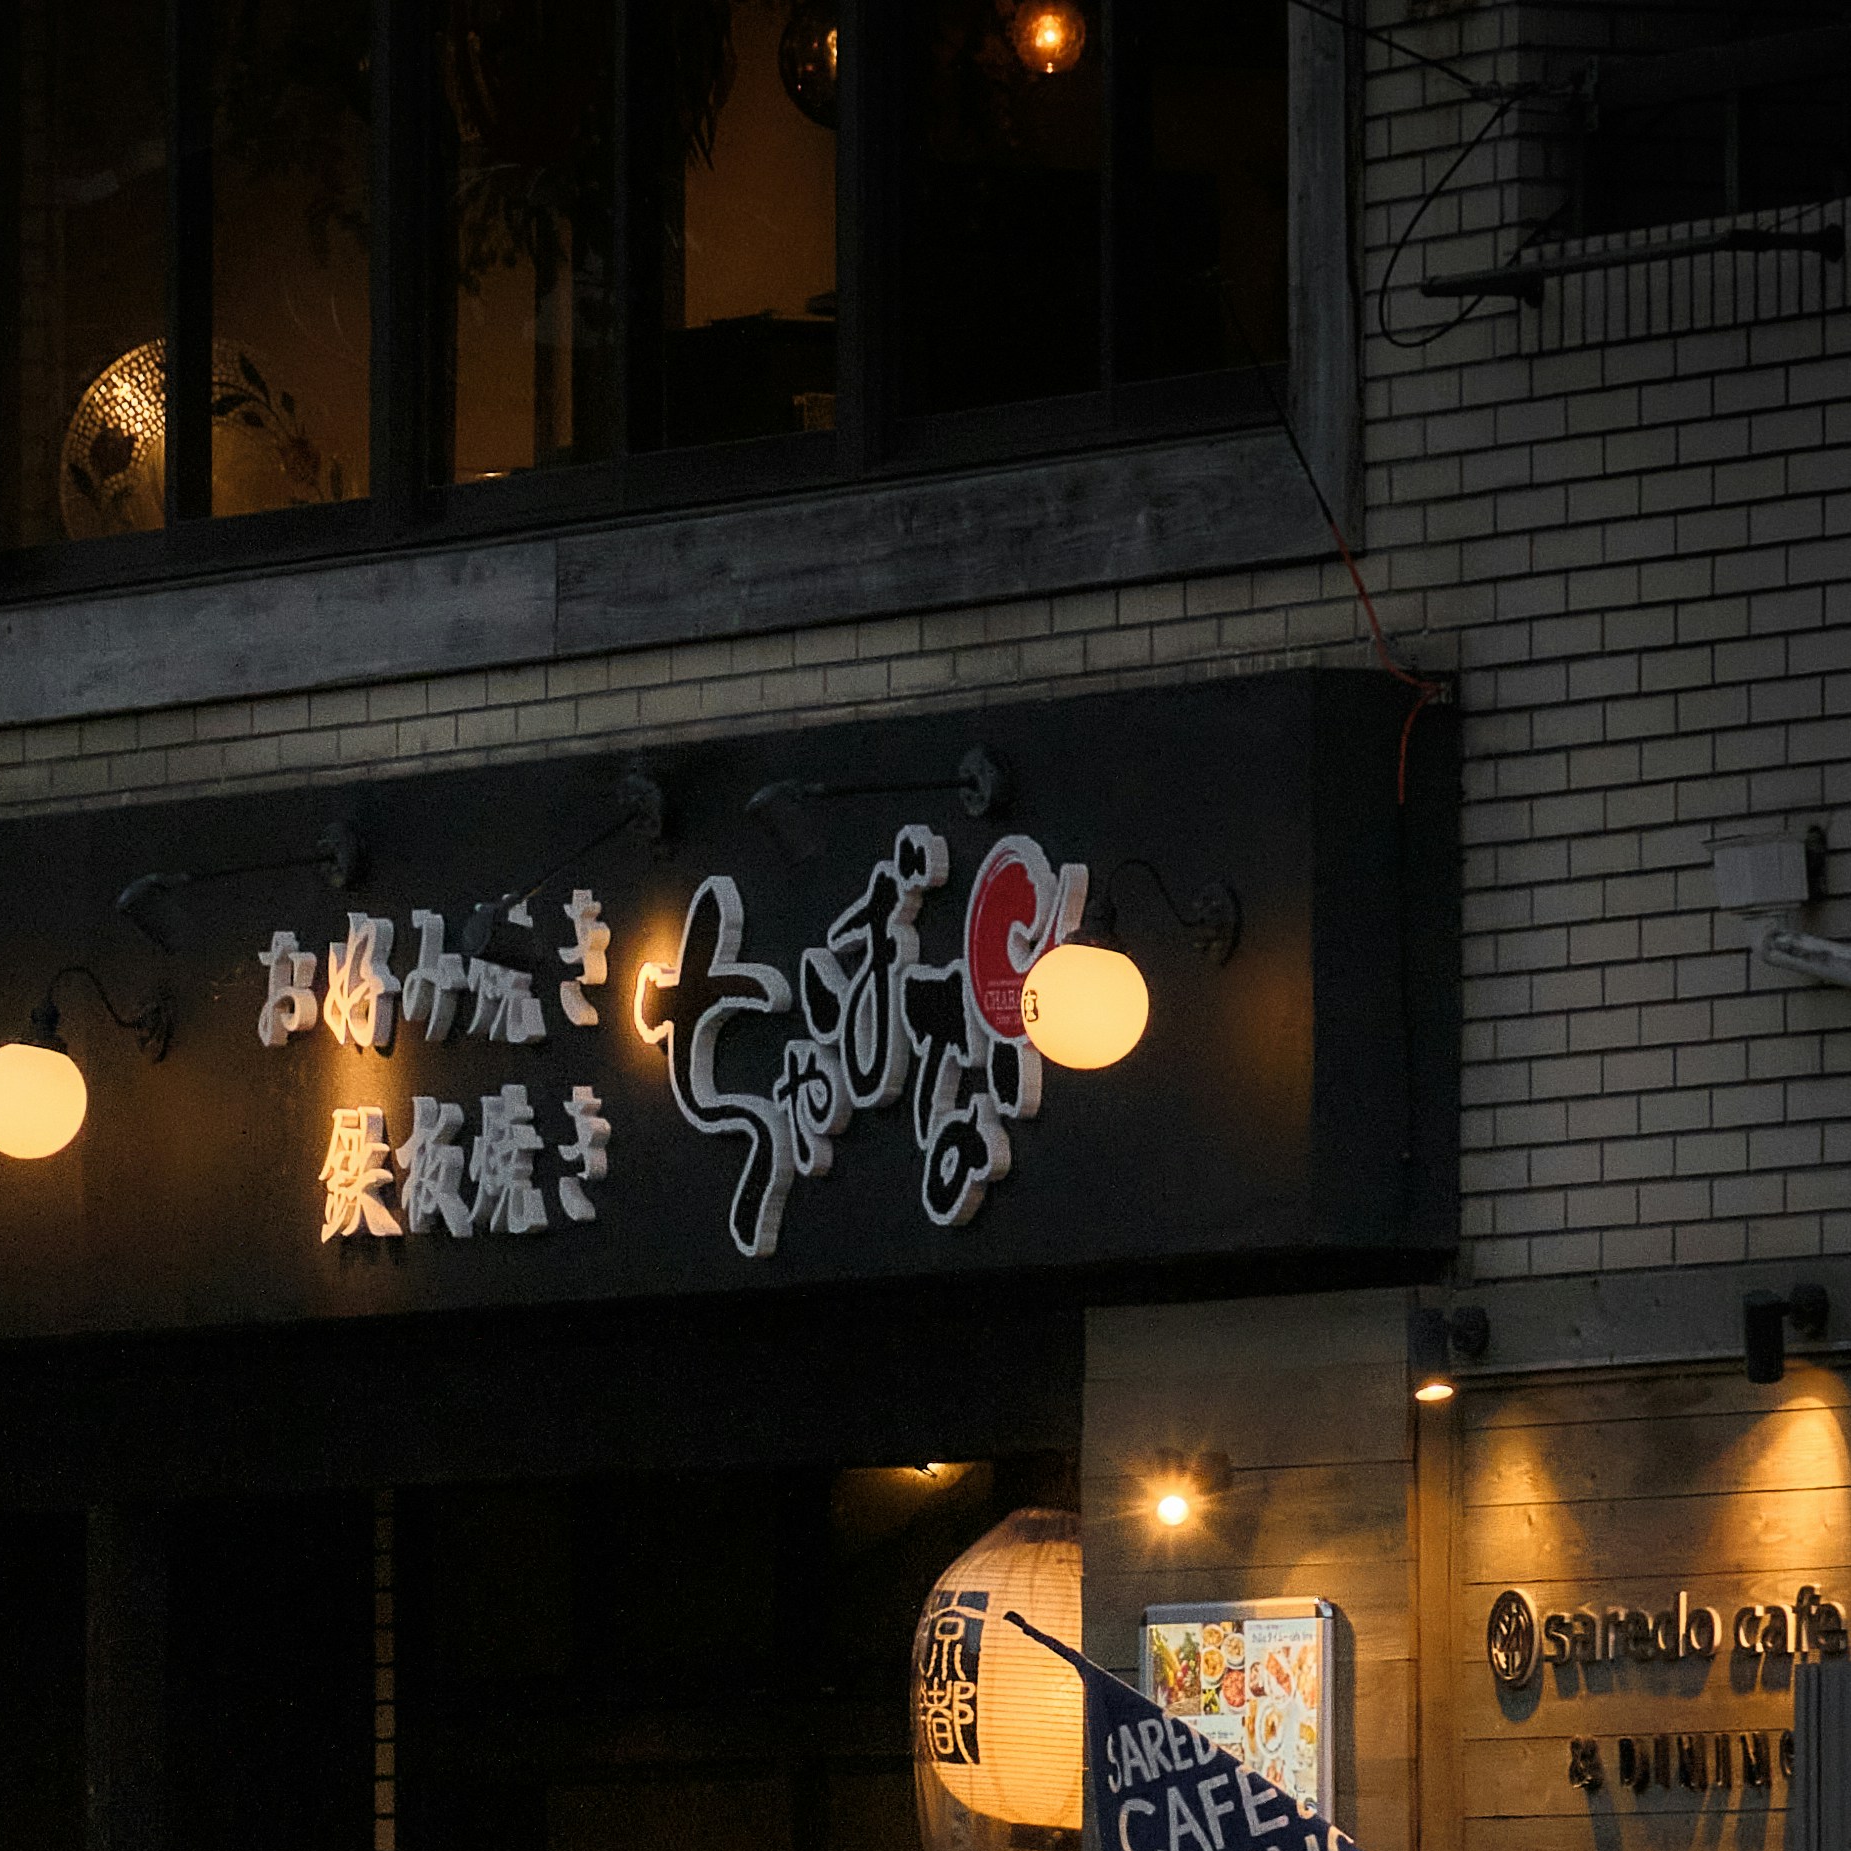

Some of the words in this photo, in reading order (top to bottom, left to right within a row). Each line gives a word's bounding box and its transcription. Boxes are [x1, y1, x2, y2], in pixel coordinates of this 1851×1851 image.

[259, 888, 611, 1047] お好み焼き
[319, 1083, 611, 1242] 鉄板焼き
[918, 1590, 989, 1764] 京都
[1545, 1589, 1723, 1665] saredo
